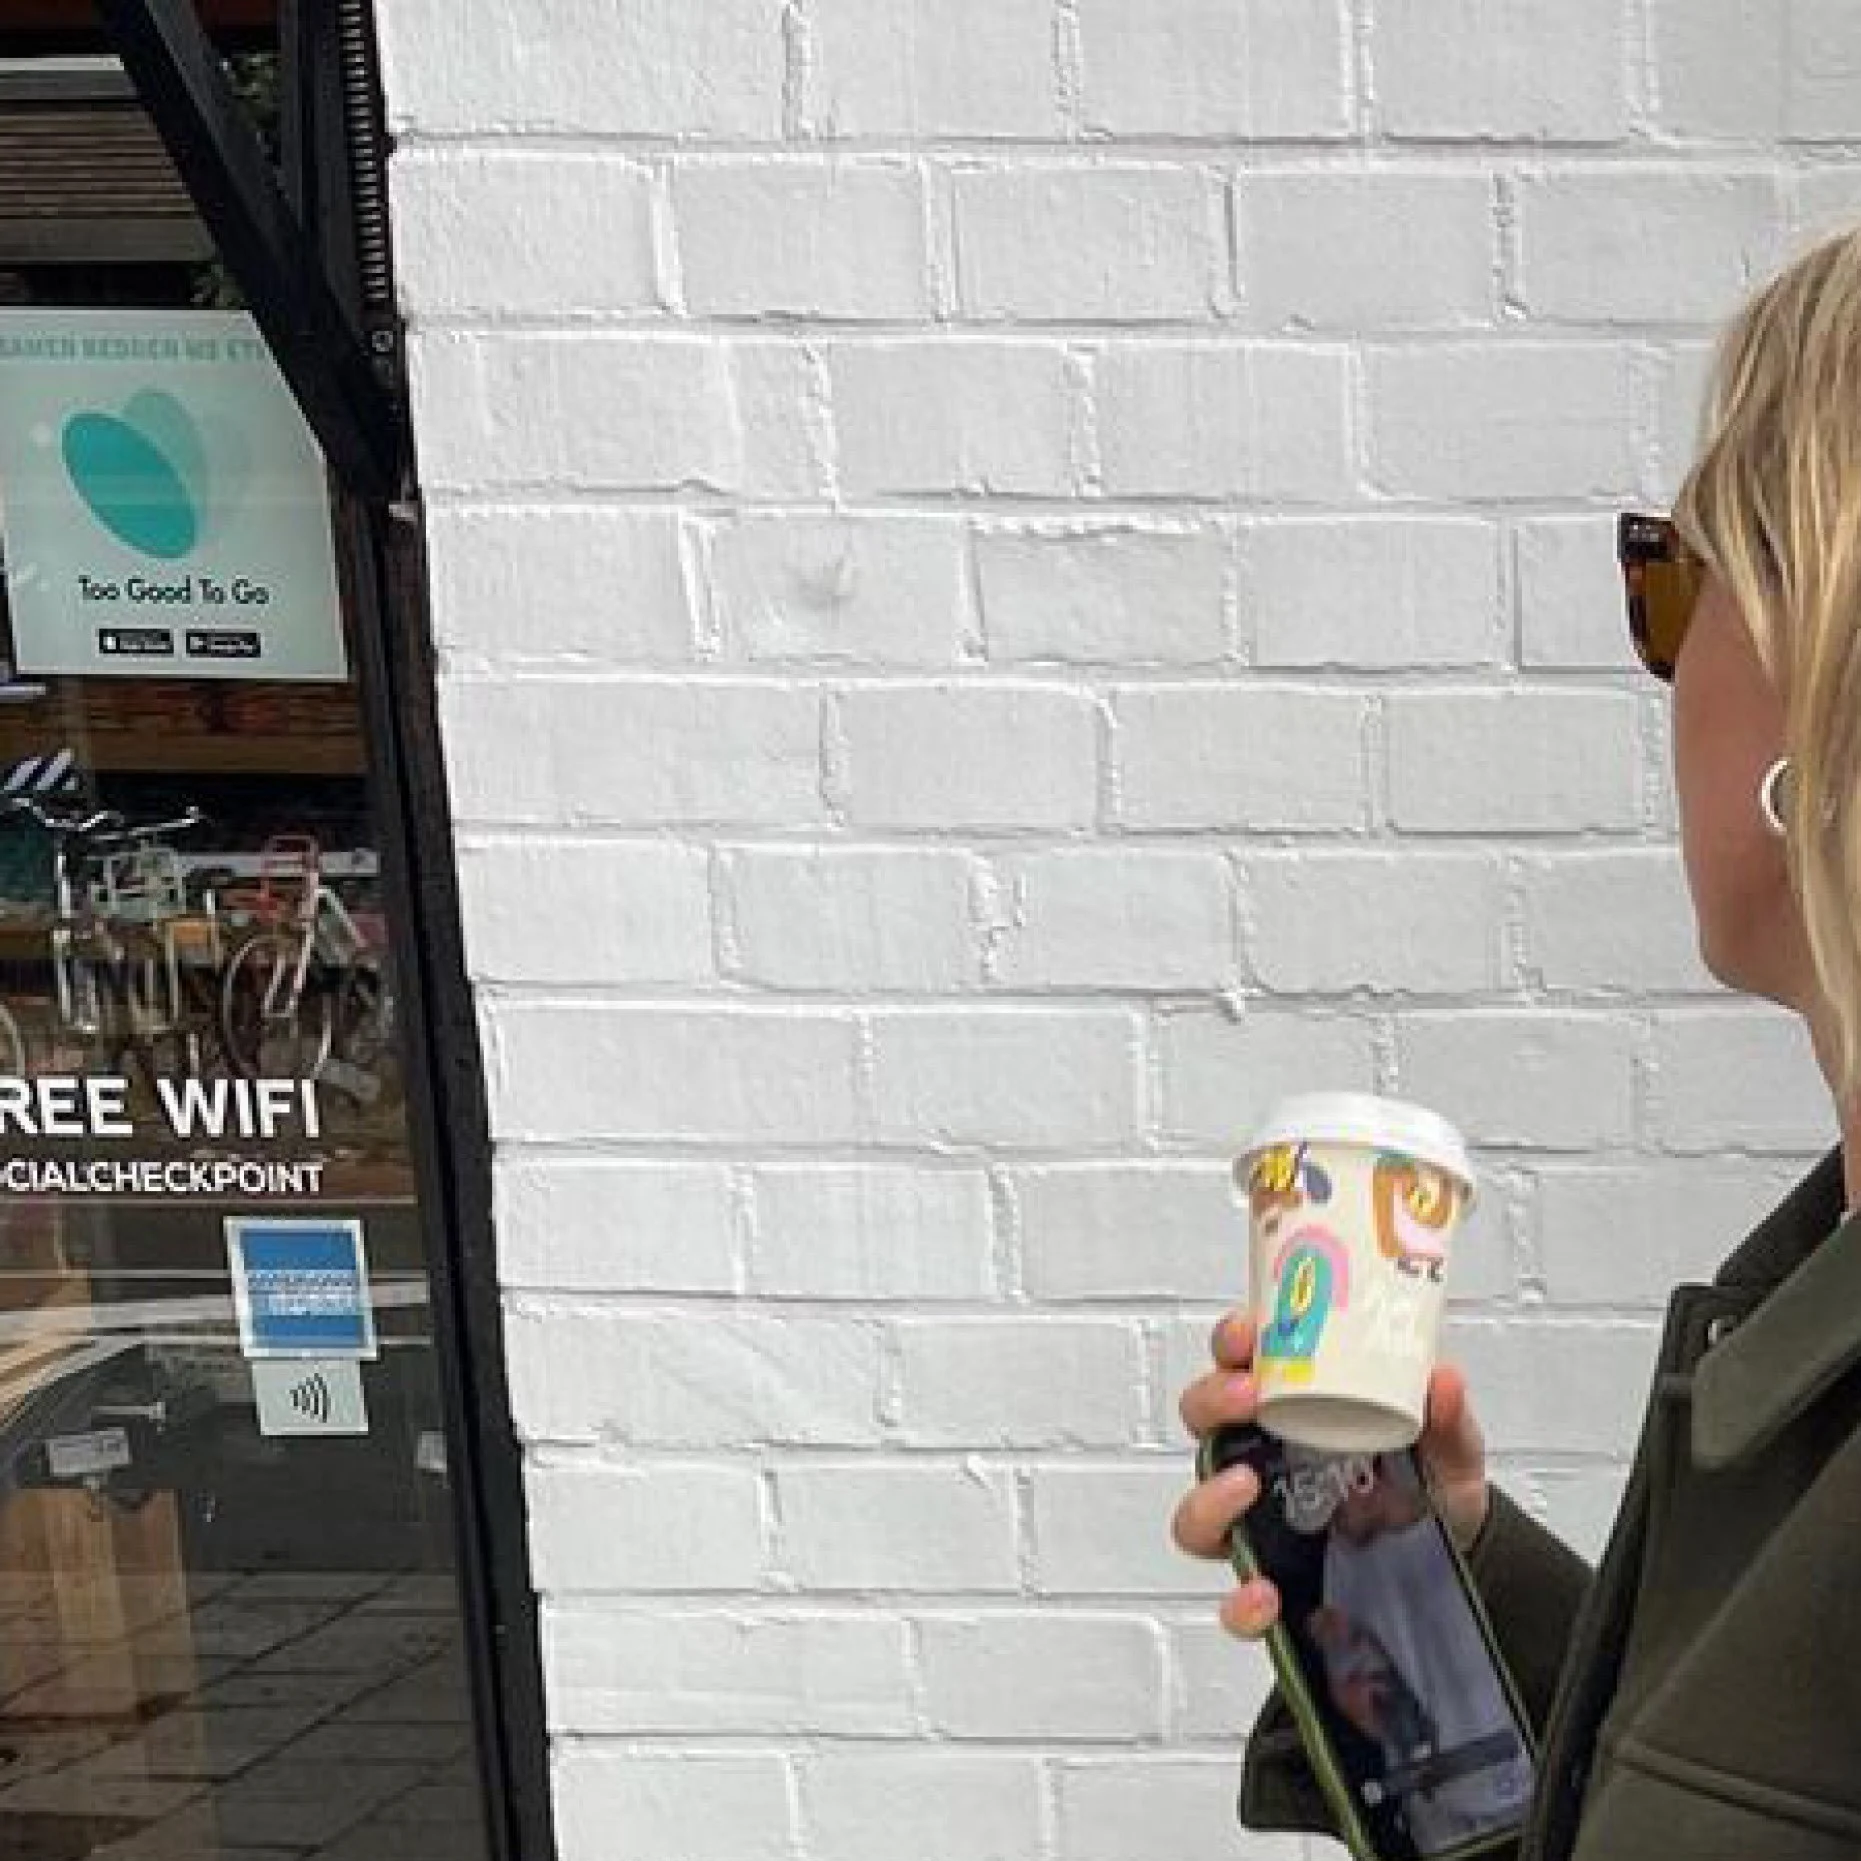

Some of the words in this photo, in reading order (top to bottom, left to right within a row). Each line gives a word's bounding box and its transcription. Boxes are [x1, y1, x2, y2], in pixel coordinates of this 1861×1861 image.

[78, 574, 121, 602] Too
[126, 574, 191, 605] Good
[199, 578, 226, 605] To
[231, 578, 270, 605] Go
[156, 1077, 320, 1139] WIFI
